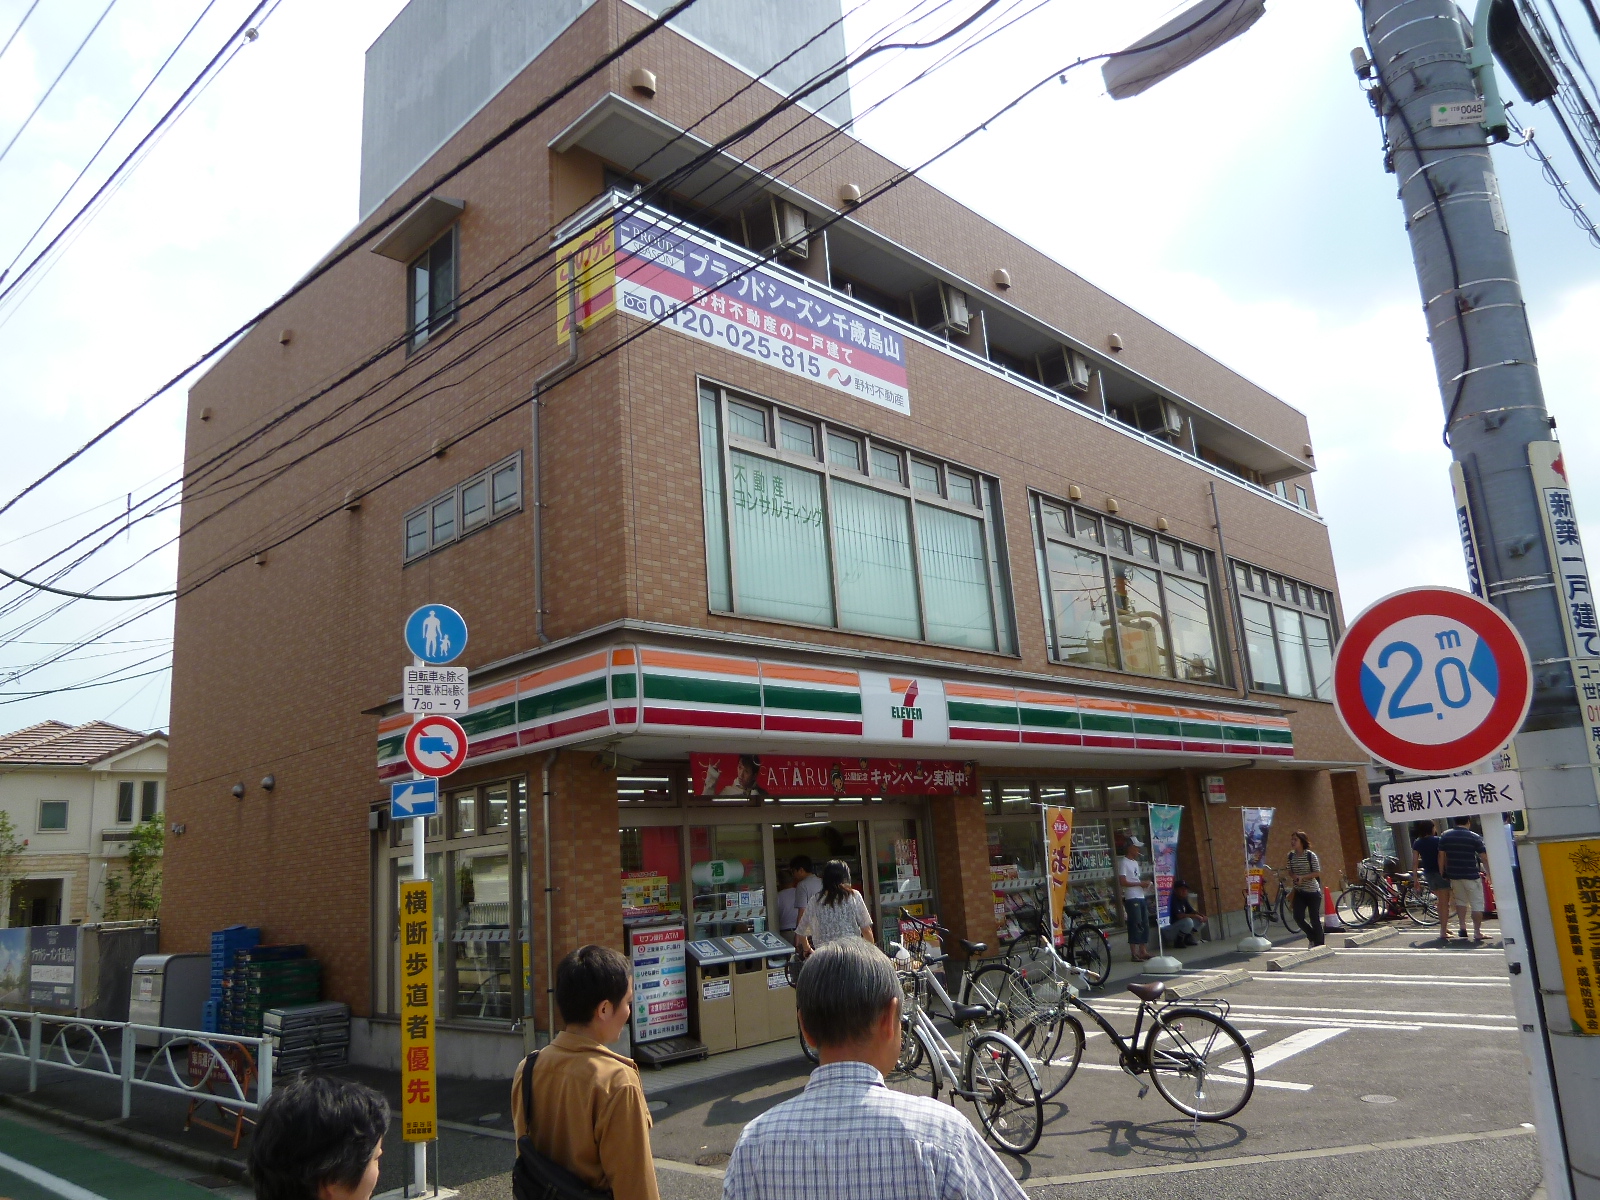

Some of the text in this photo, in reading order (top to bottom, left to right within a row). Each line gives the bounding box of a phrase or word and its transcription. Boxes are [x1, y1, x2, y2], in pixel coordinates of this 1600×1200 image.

[1460, 104, 1483, 114] 0048
[632, 226, 674, 253] PROUD
[633, 241, 674, 267] SEASON
[650, 294, 821, 378] 0120-025-815
[692, 285, 853, 364] 野村不動産の一戸建て
[854, 377, 905, 408] 野村不動産
[733, 463, 784, 498] 不動産
[734, 489, 823, 528] コンサルティング
[1549, 491, 1600, 656] 新築一戸建て
[408, 670, 464, 683] 自転車を除く
[766, 766, 828, 787] ATARU
[1388, 783, 1513, 814] 路線バスを除く
[711, 862, 725, 877] 酒
[664, 931, 679, 940] ATM
